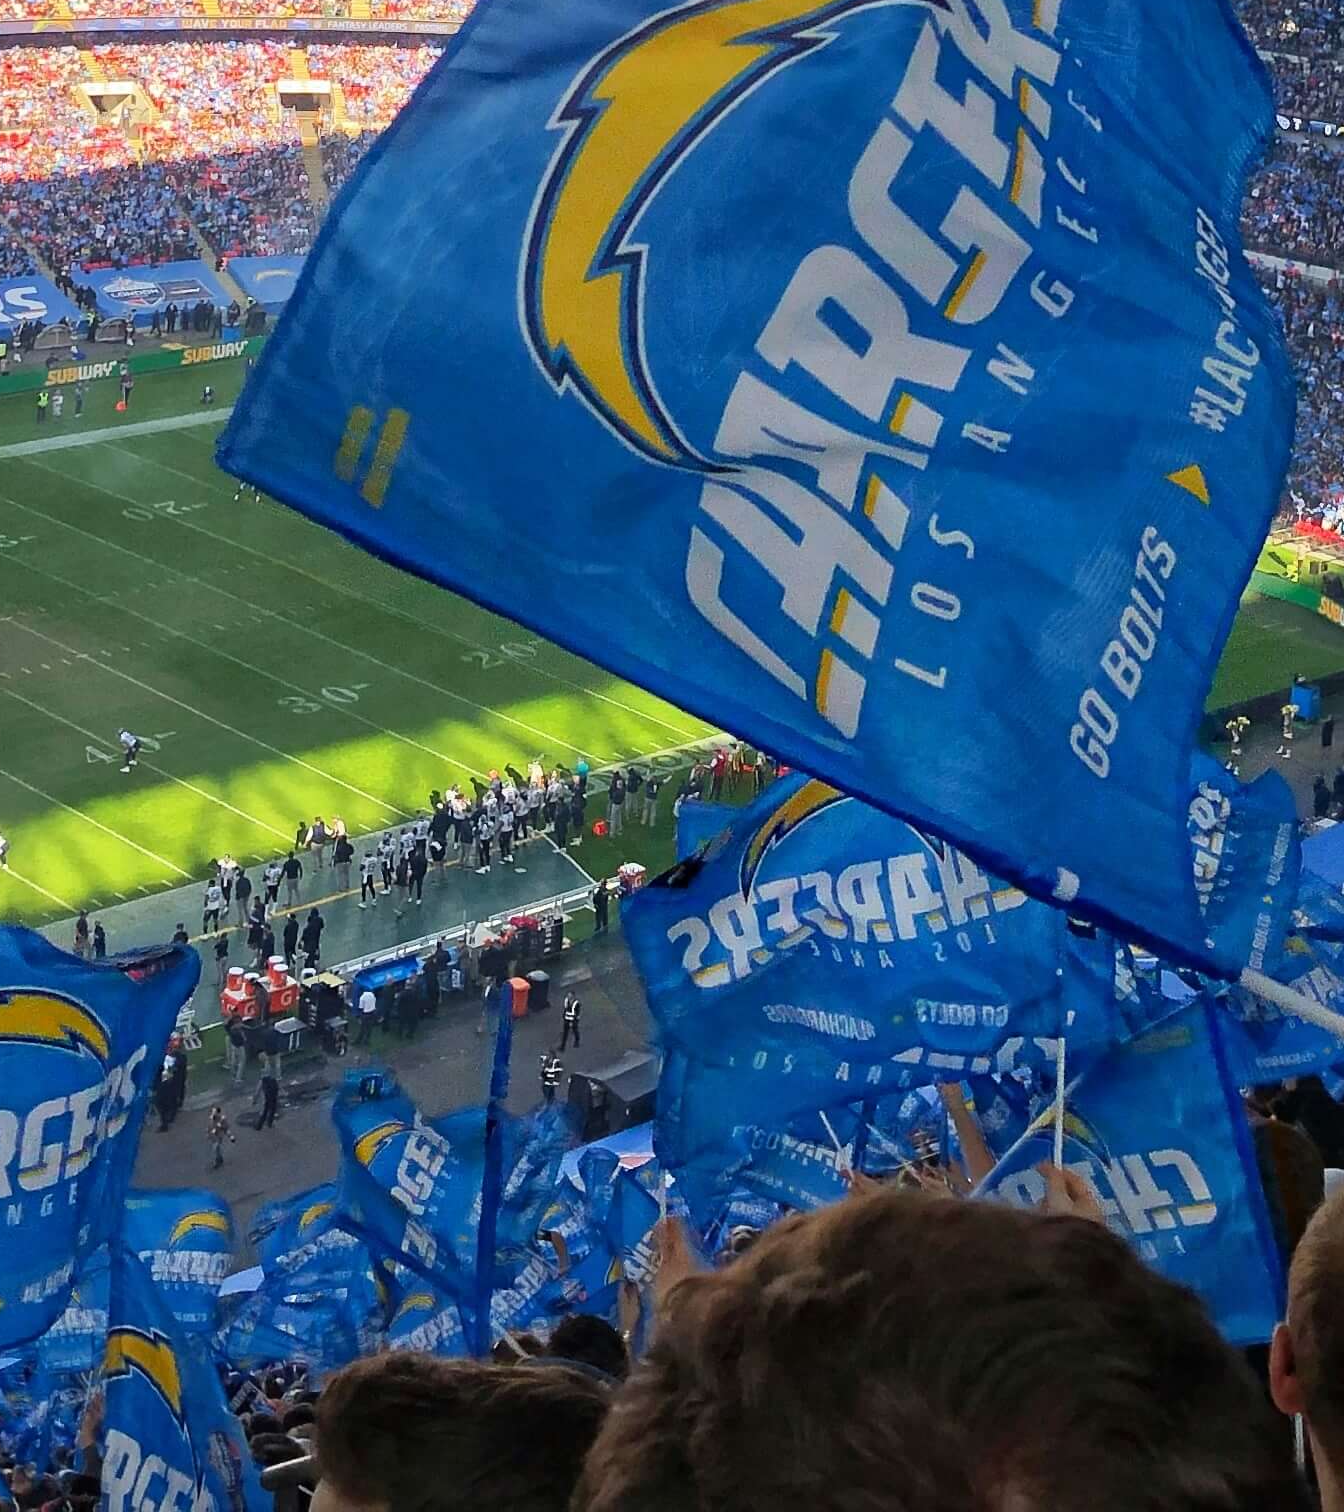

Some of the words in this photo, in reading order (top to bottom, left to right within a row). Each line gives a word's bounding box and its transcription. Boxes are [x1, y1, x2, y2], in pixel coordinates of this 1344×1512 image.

[219, 19, 252, 30] YOUR
[256, 19, 288, 30] FLAG
[327, 20, 366, 31] FANTASY
[368, 22, 407, 32] LEADERS
[182, 340, 248, 366] SUBWAY
[44, 359, 117, 387] SUBWAY
[893, 510, 977, 689] LOS
[1069, 687, 1120, 780] GO
[1100, 524, 1177, 702] BOLTS
